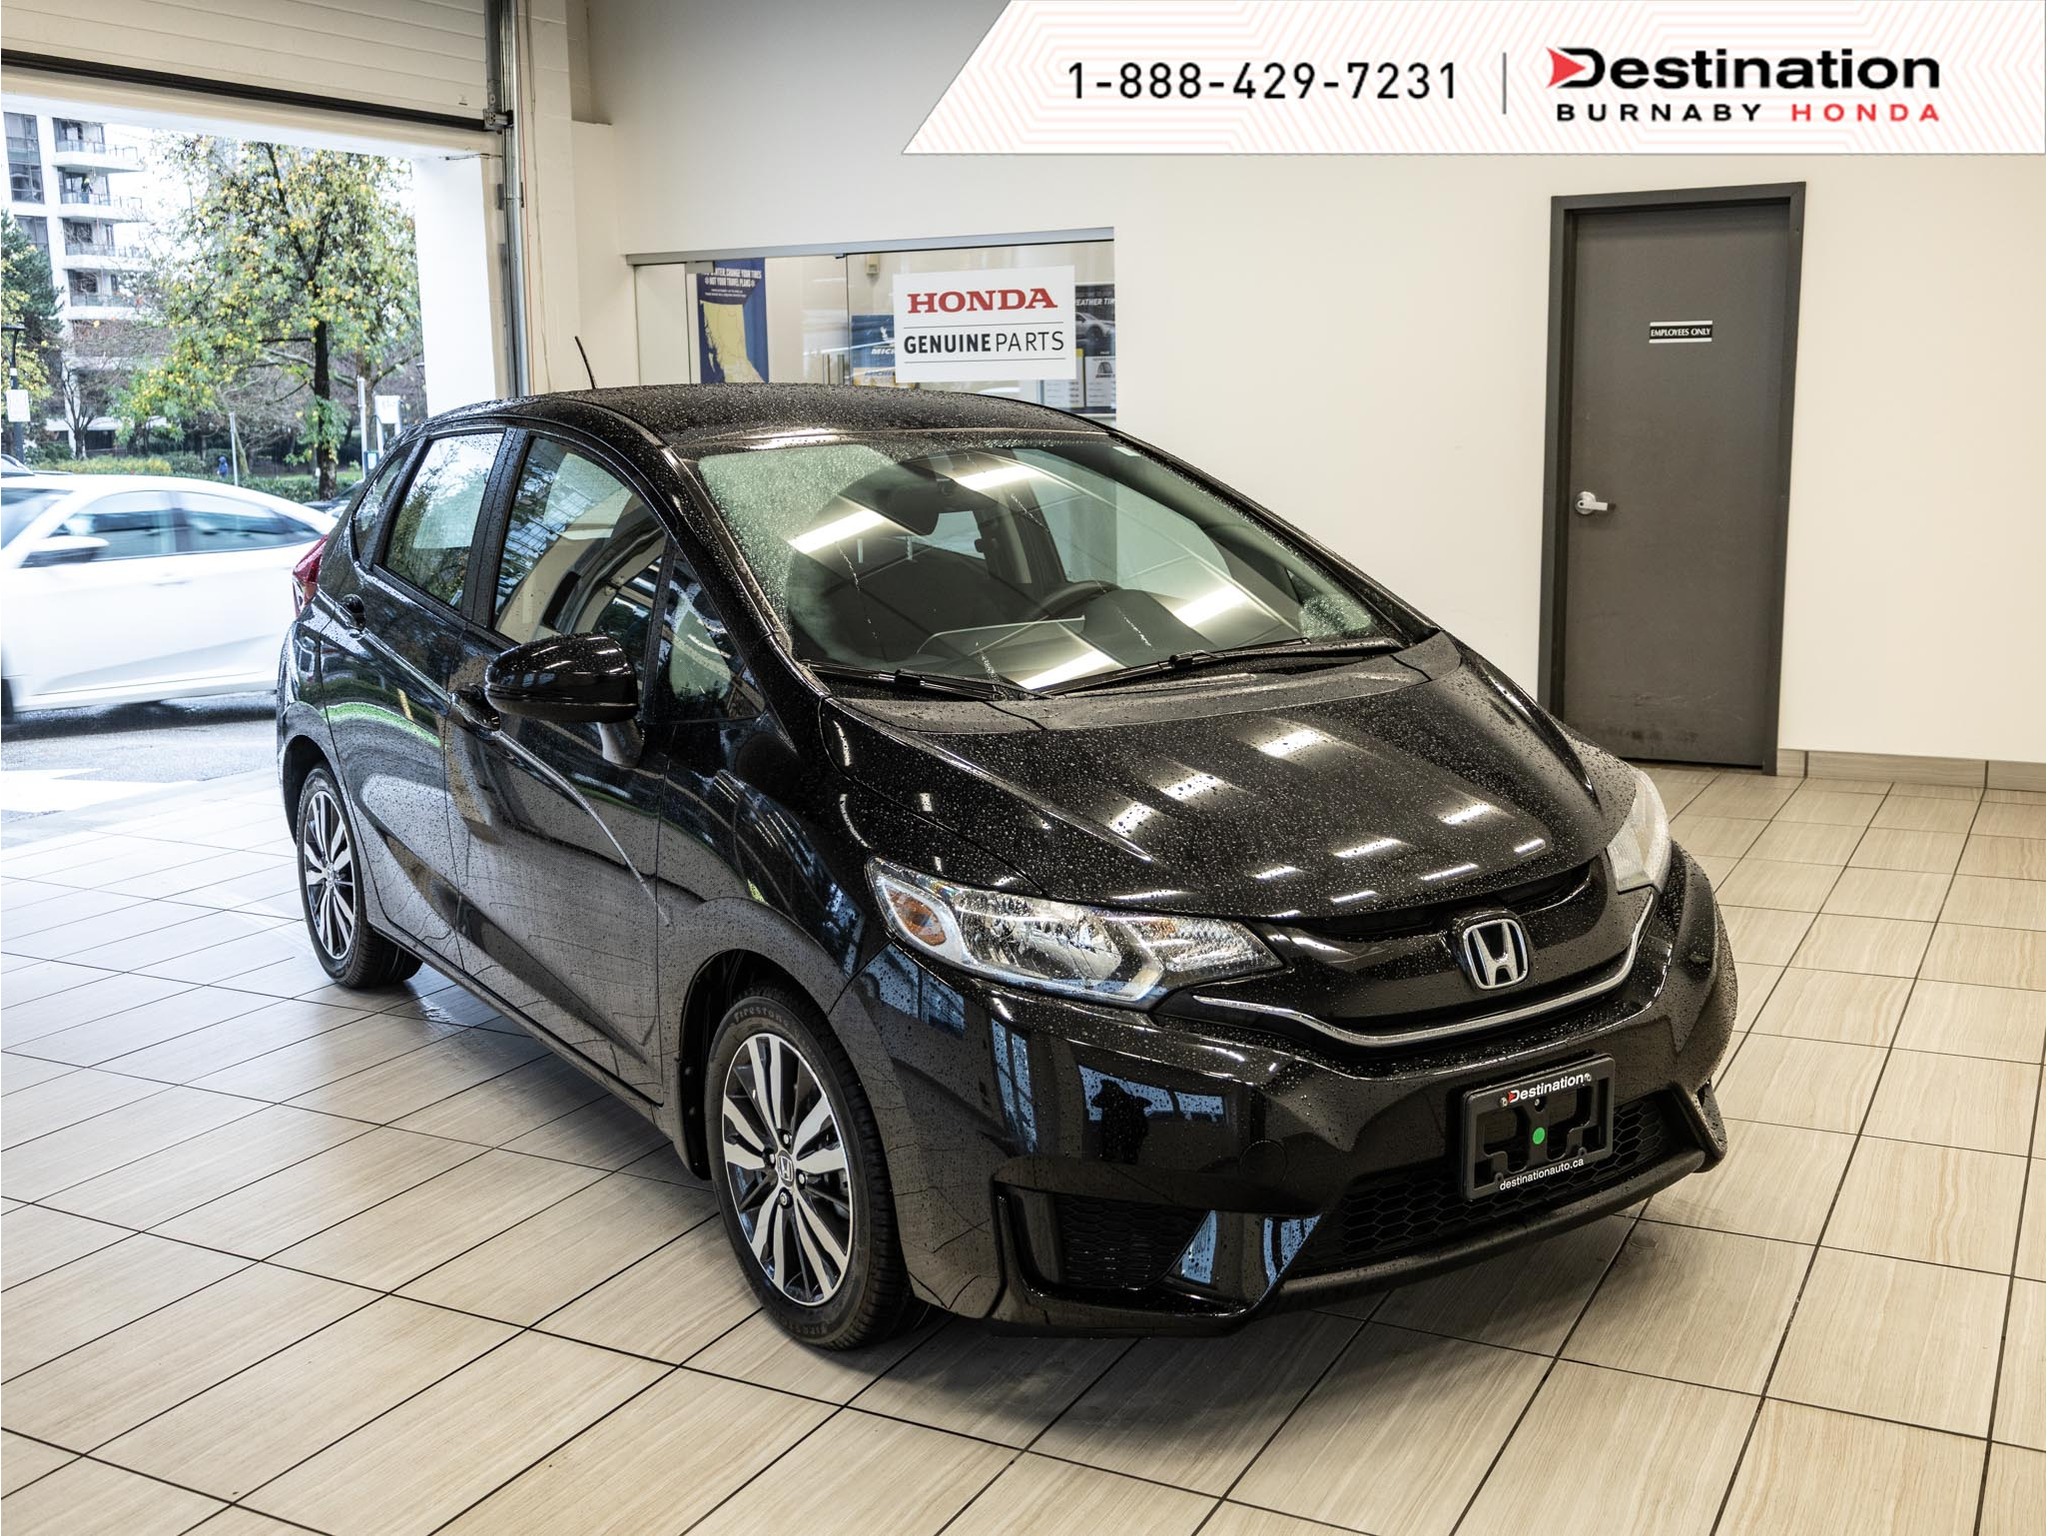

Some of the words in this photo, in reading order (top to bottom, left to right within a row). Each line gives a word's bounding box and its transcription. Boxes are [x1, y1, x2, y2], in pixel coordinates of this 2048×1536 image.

[906, 287, 1058, 314] HONDA
[903, 332, 992, 355] GENUINE
[995, 330, 1065, 352] PARTS
[1650, 328, 1690, 337] EMPLOYEES
[1690, 327, 1712, 336] ONLY
[1508, 1072, 1585, 1104] Destination
[1499, 1157, 1585, 1191] destinationauto.ca
